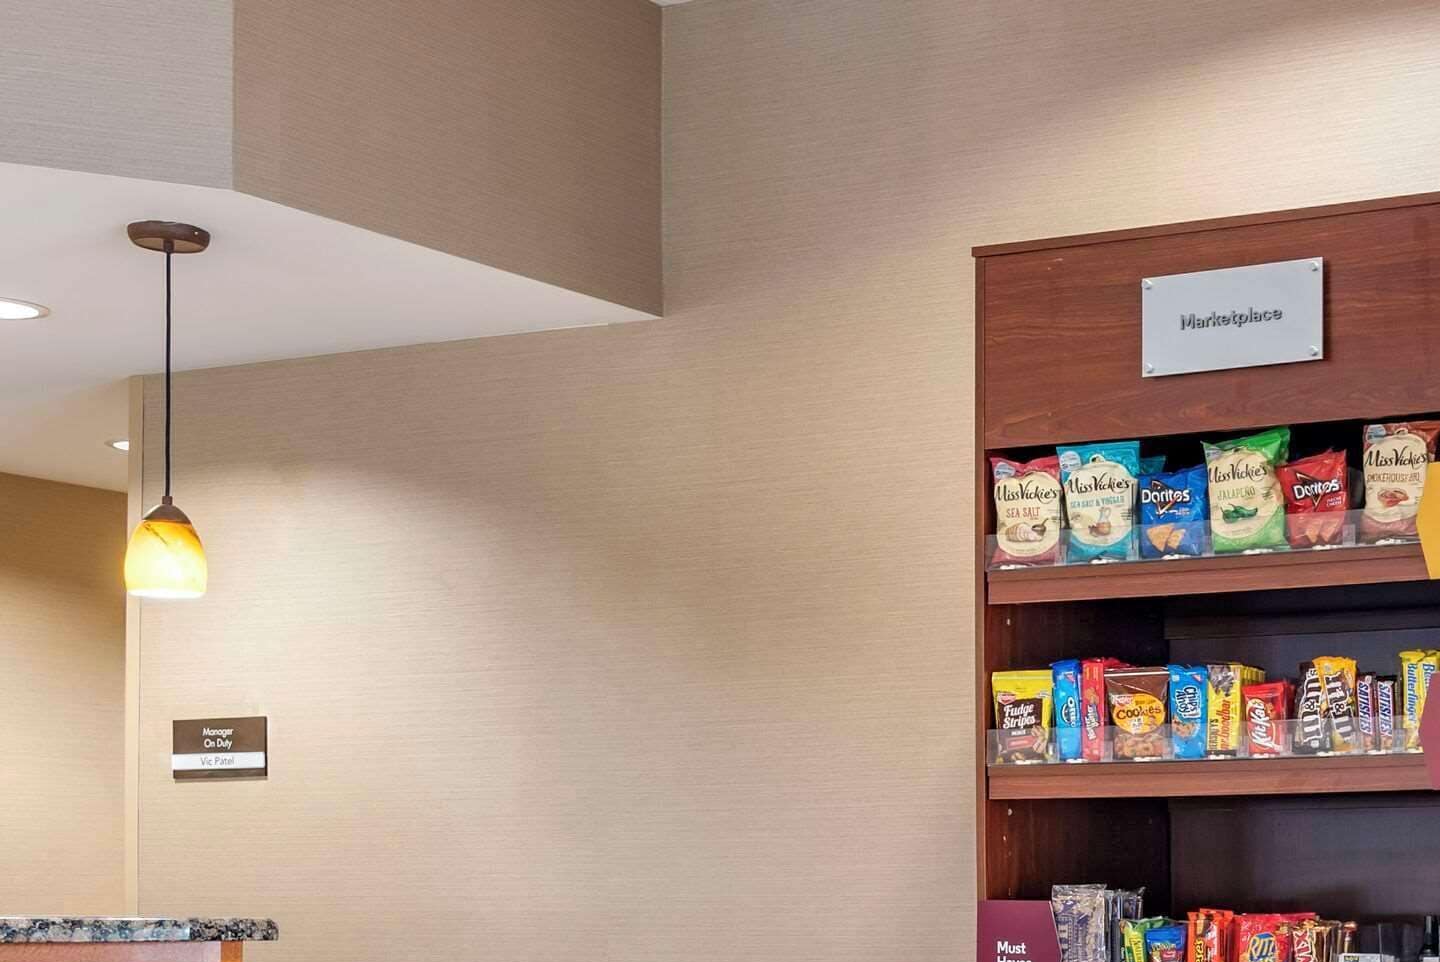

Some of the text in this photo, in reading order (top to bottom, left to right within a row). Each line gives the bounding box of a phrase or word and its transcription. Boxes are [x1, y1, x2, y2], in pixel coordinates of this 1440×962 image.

[1180, 307, 1283, 331] Marketplace
[1141, 488, 1190, 504] Doritos
[1293, 479, 1340, 500] Doritos
[1006, 506, 1041, 518] SEA SALT
[1003, 703, 1034, 718] Fudge
[1359, 682, 1373, 735] SATISFIES
[1003, 715, 1036, 729] Stripes
[202, 728, 234, 738] Manager
[203, 738, 232, 749] On Duty
[201, 757, 234, 766] Vic Patel
[996, 941, 1026, 954] Must
